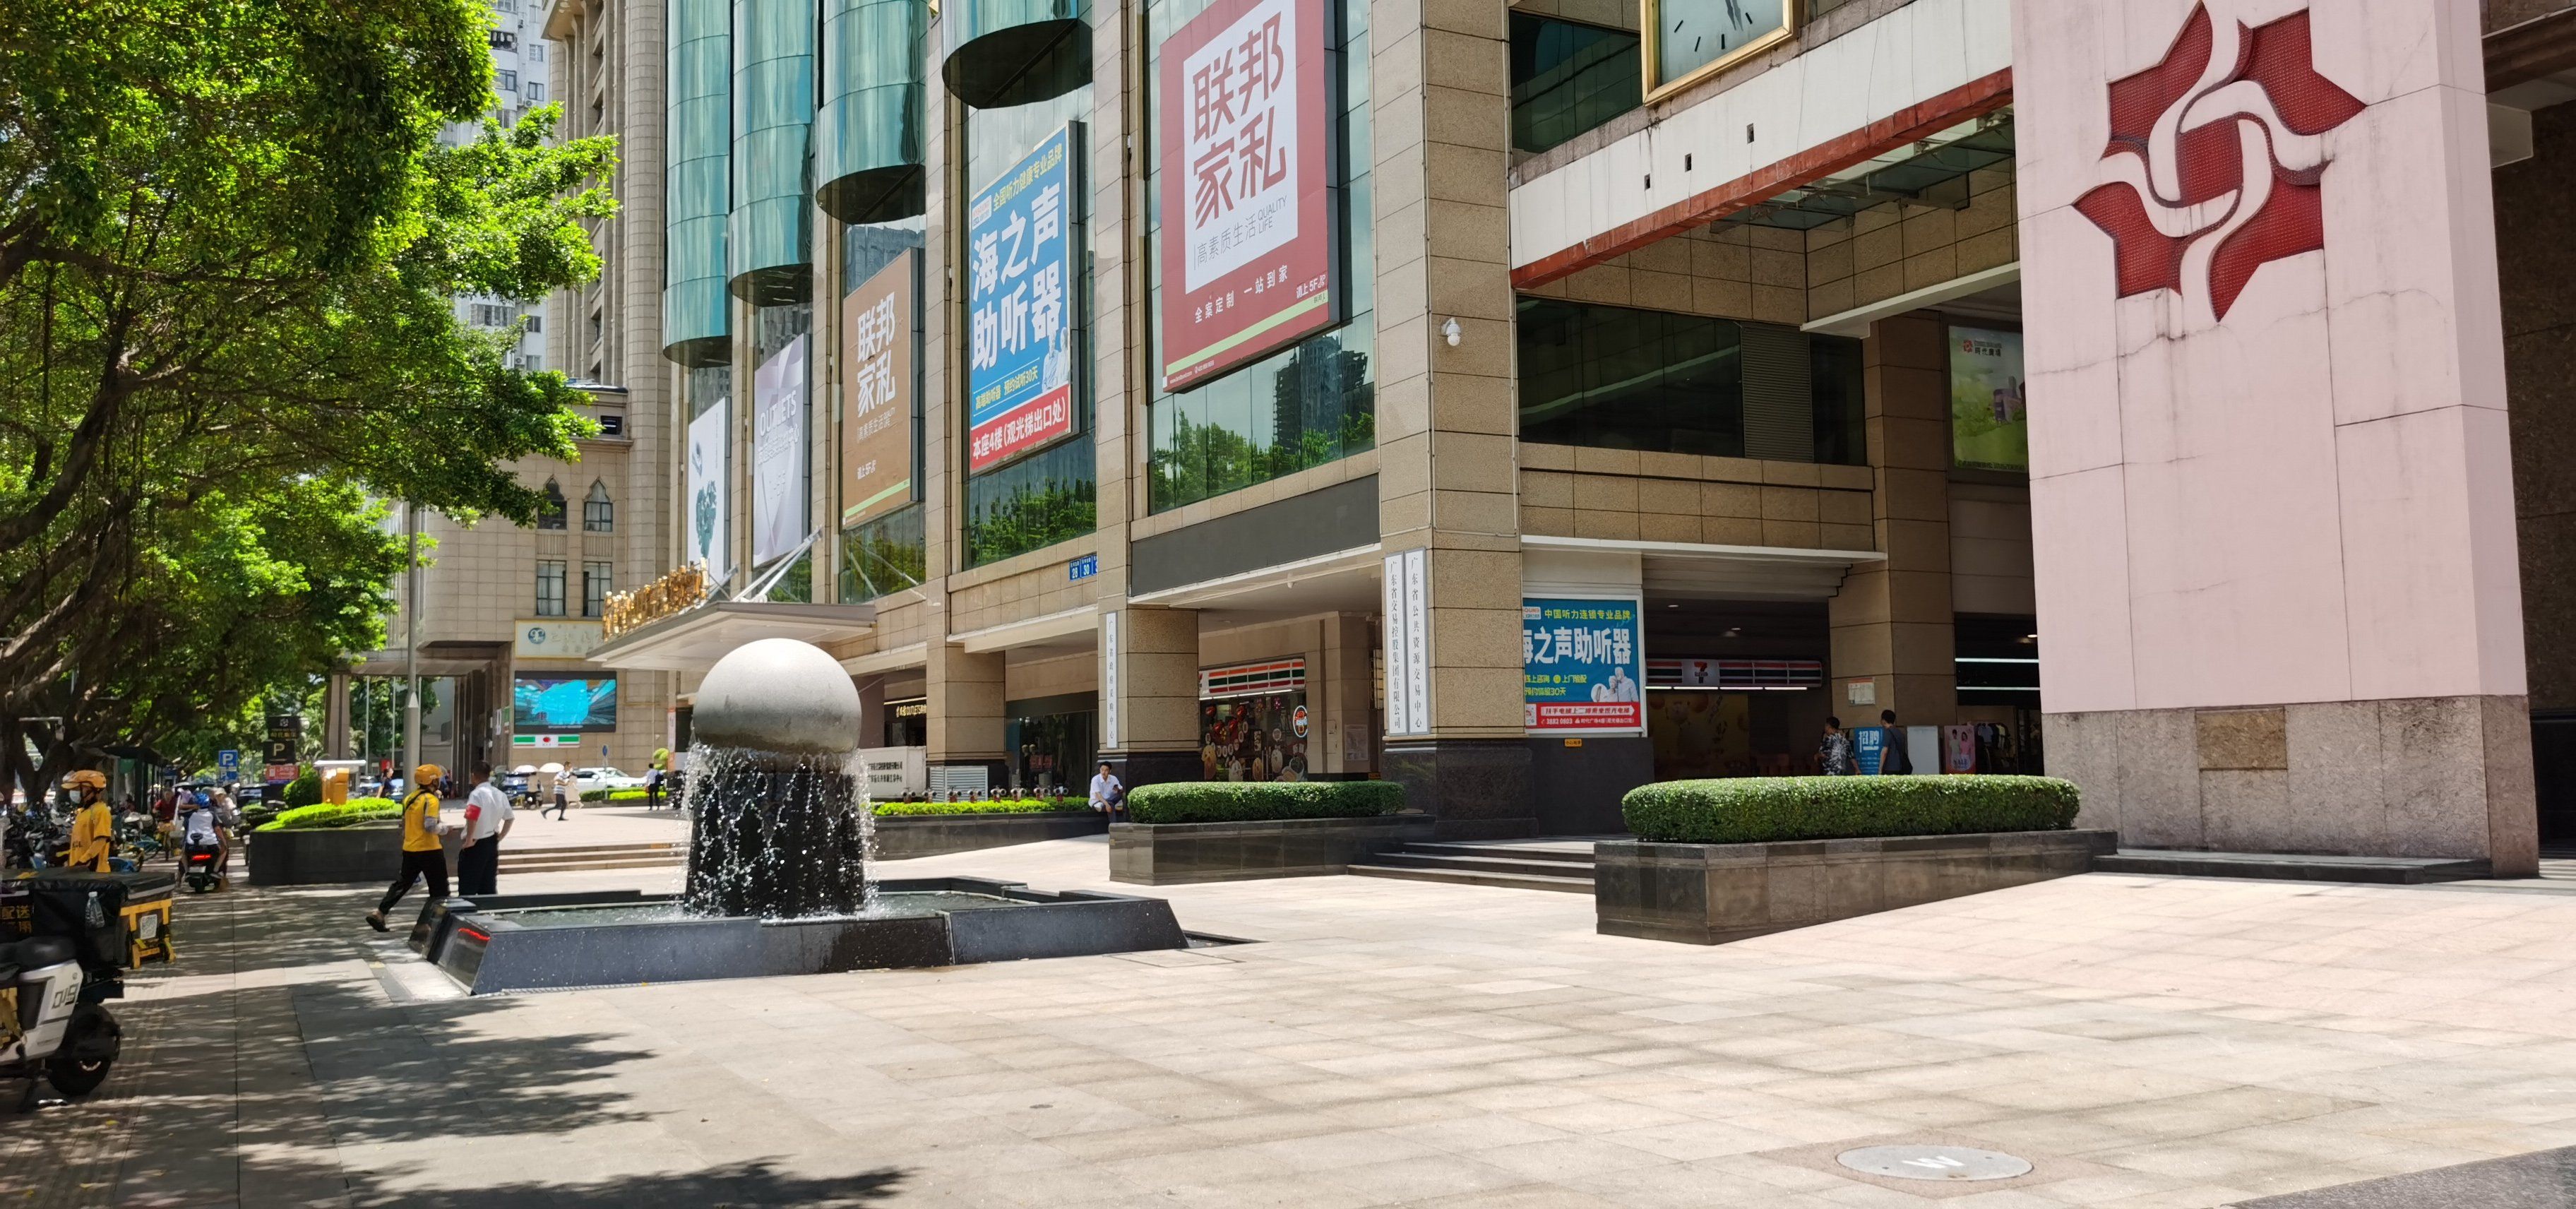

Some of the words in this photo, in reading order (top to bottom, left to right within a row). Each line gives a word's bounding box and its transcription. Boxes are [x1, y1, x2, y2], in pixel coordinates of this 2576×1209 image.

[1193, 11, 1284, 145] 联邦
[994, 143, 1062, 212] 全国听力健康专业品牌
[1193, 105, 1287, 230] 家私
[1258, 195, 1287, 220] QUALITY
[1258, 216, 1273, 234] LIFE
[972, 182, 1060, 302] 海之声
[1198, 213, 1256, 267] 高素质生活
[972, 260, 1061, 371] 助听器
[1195, 290, 1234, 323] 全案定制
[1244, 265, 1288, 294] 一站到家
[857, 292, 895, 363] 联邦
[857, 350, 895, 418] 家私
[975, 384, 1001, 410] 高端助听器
[1003, 365, 1038, 395] 预约试听30天
[760, 390, 797, 437] OUTLETS
[973, 396, 1066, 460] 本座4楼(观光梯出口处)
[1083, 564, 1090, 576] 30
[1411, 556, 1422, 728] 广东省公共资源交易中心
[1544, 609, 1632, 620] 中国听力连锁专业品牌
[1390, 561, 1401, 729] 广东省交易控股集团有限公司
[1694, 661, 1707, 684] 7
[222, 753, 234, 766] P
[274, 743, 286, 757] P
[1859, 729, 1880, 753] 招聘
